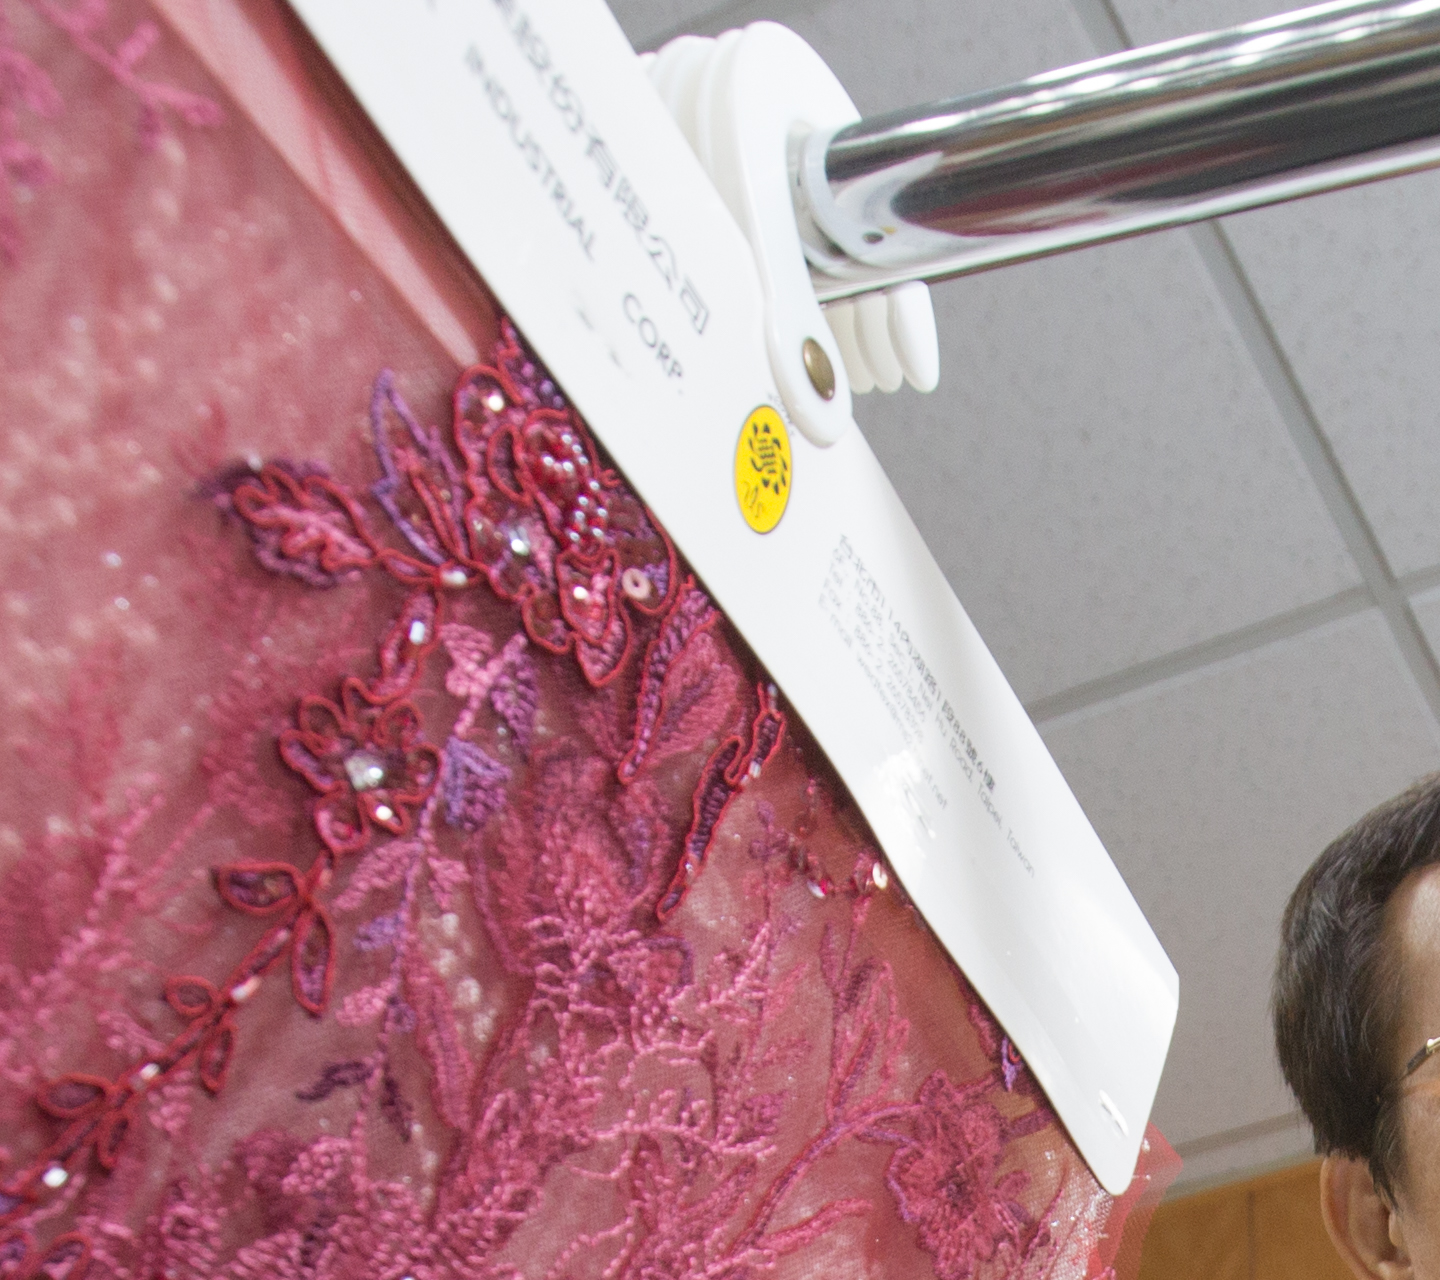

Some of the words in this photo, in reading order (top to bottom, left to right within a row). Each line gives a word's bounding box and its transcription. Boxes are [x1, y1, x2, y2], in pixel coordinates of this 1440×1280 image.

[463, 40, 596, 264] INDUSTRIAL
[624, 289, 684, 398] CORP.
[917, 680, 933, 712] Nei
[934, 710, 946, 738] Hu
[1006, 827, 1035, 879] Taiwan
